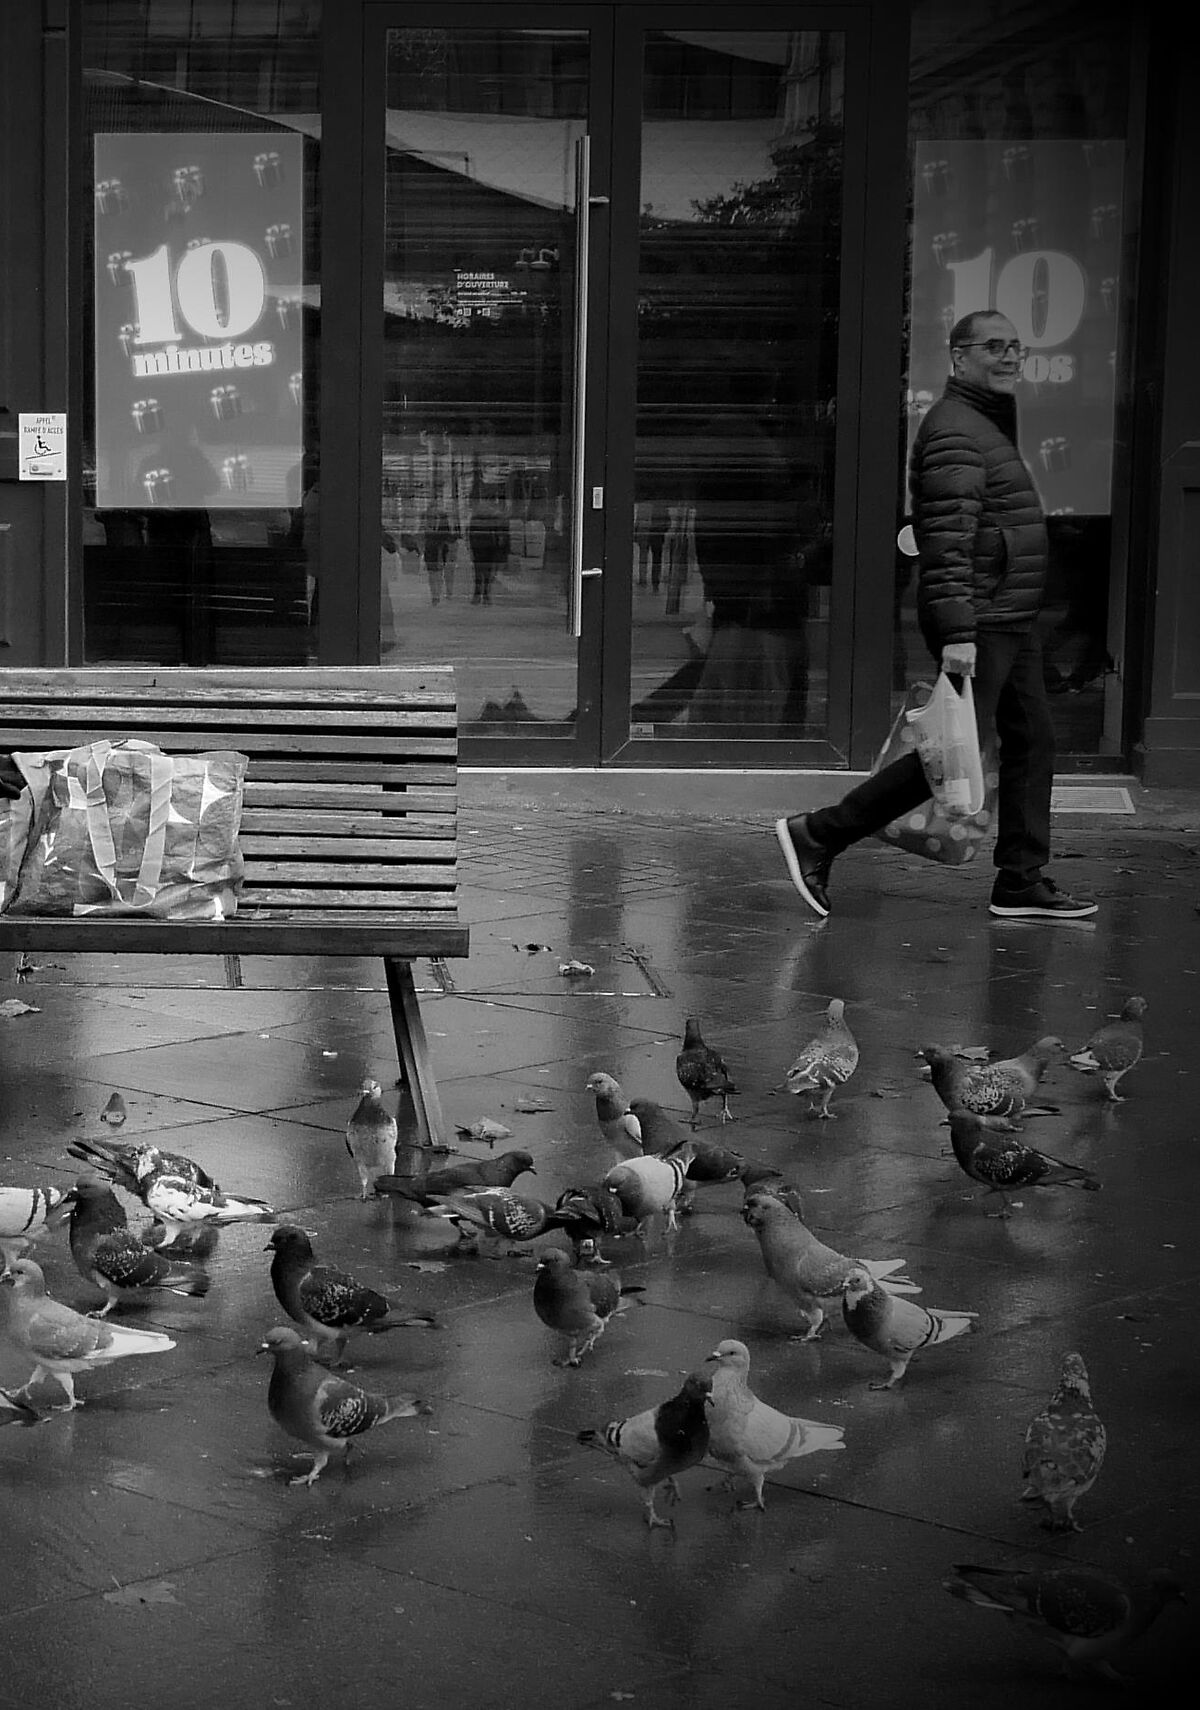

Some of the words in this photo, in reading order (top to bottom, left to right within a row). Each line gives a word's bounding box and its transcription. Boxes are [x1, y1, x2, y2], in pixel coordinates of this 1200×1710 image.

[124, 240, 265, 344] 10
[457, 272, 495, 280] HORAIRES
[132, 342, 274, 377] minutes
